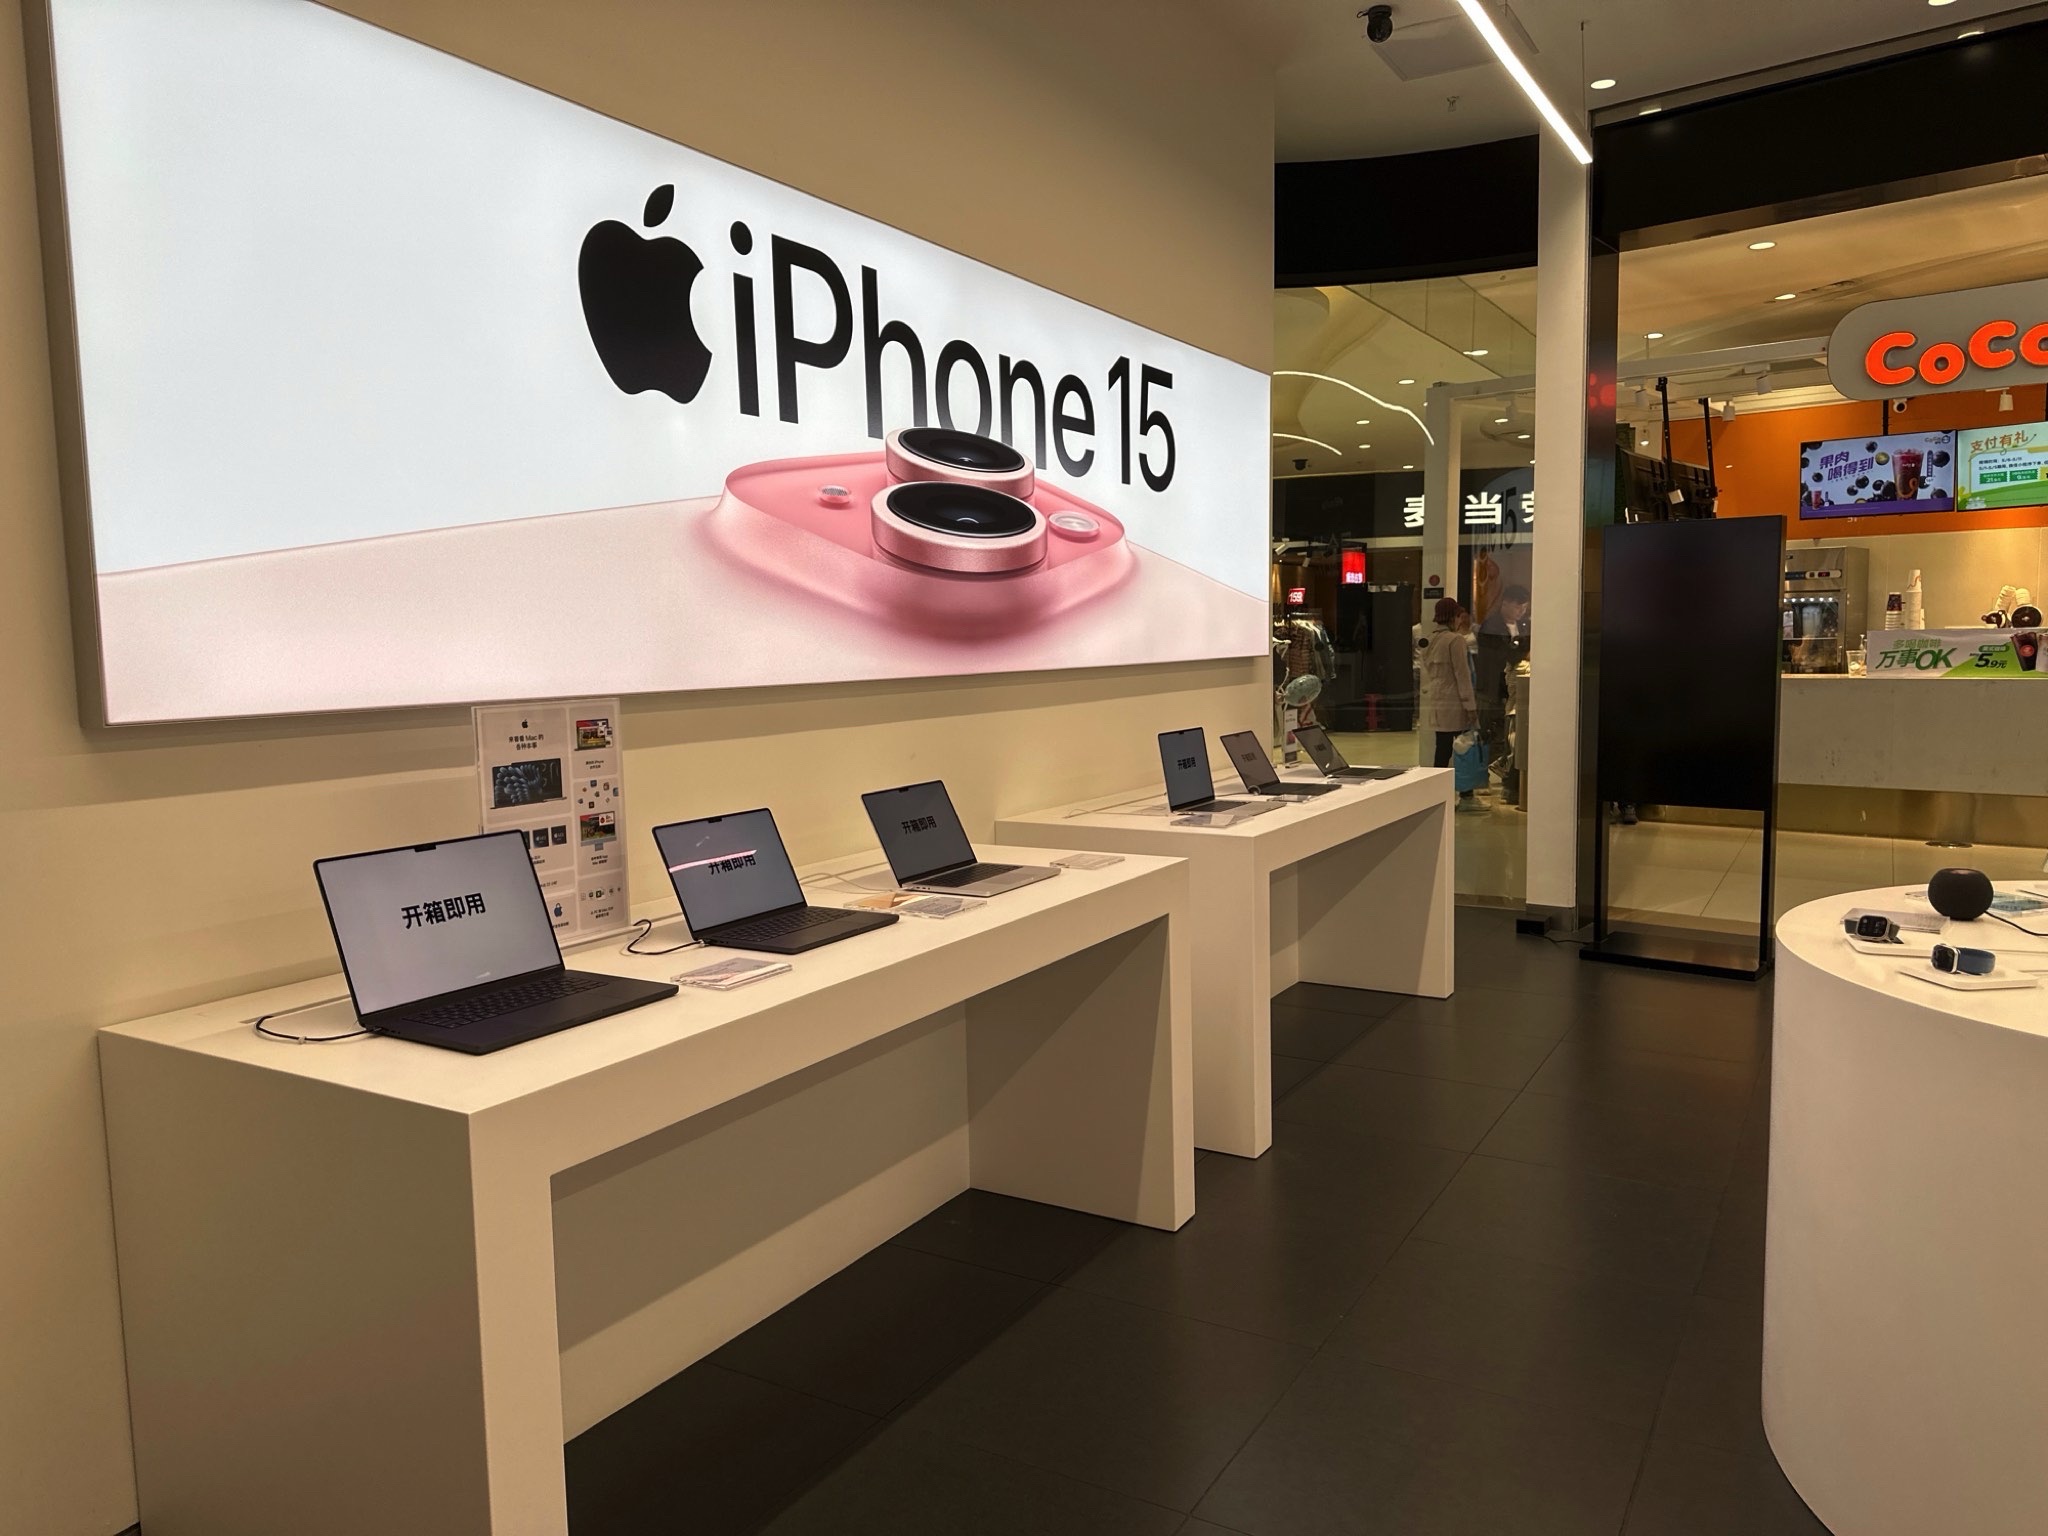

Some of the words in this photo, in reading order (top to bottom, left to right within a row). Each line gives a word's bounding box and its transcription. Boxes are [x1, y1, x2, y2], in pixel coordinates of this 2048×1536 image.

[729, 220, 1096, 478] iPhone
[1107, 355, 1176, 492] 15
[1971, 430, 2028, 453] 支付有礼
[1820, 451, 1850, 469] 果肉
[1828, 457, 1874, 480] 喝得到
[1893, 639, 1942, 649] 多喝咖啡
[1876, 648, 1957, 670] 万事OK
[902, 816, 937, 834] 开箱即用
[401, 893, 486, 929] 开箱即用
